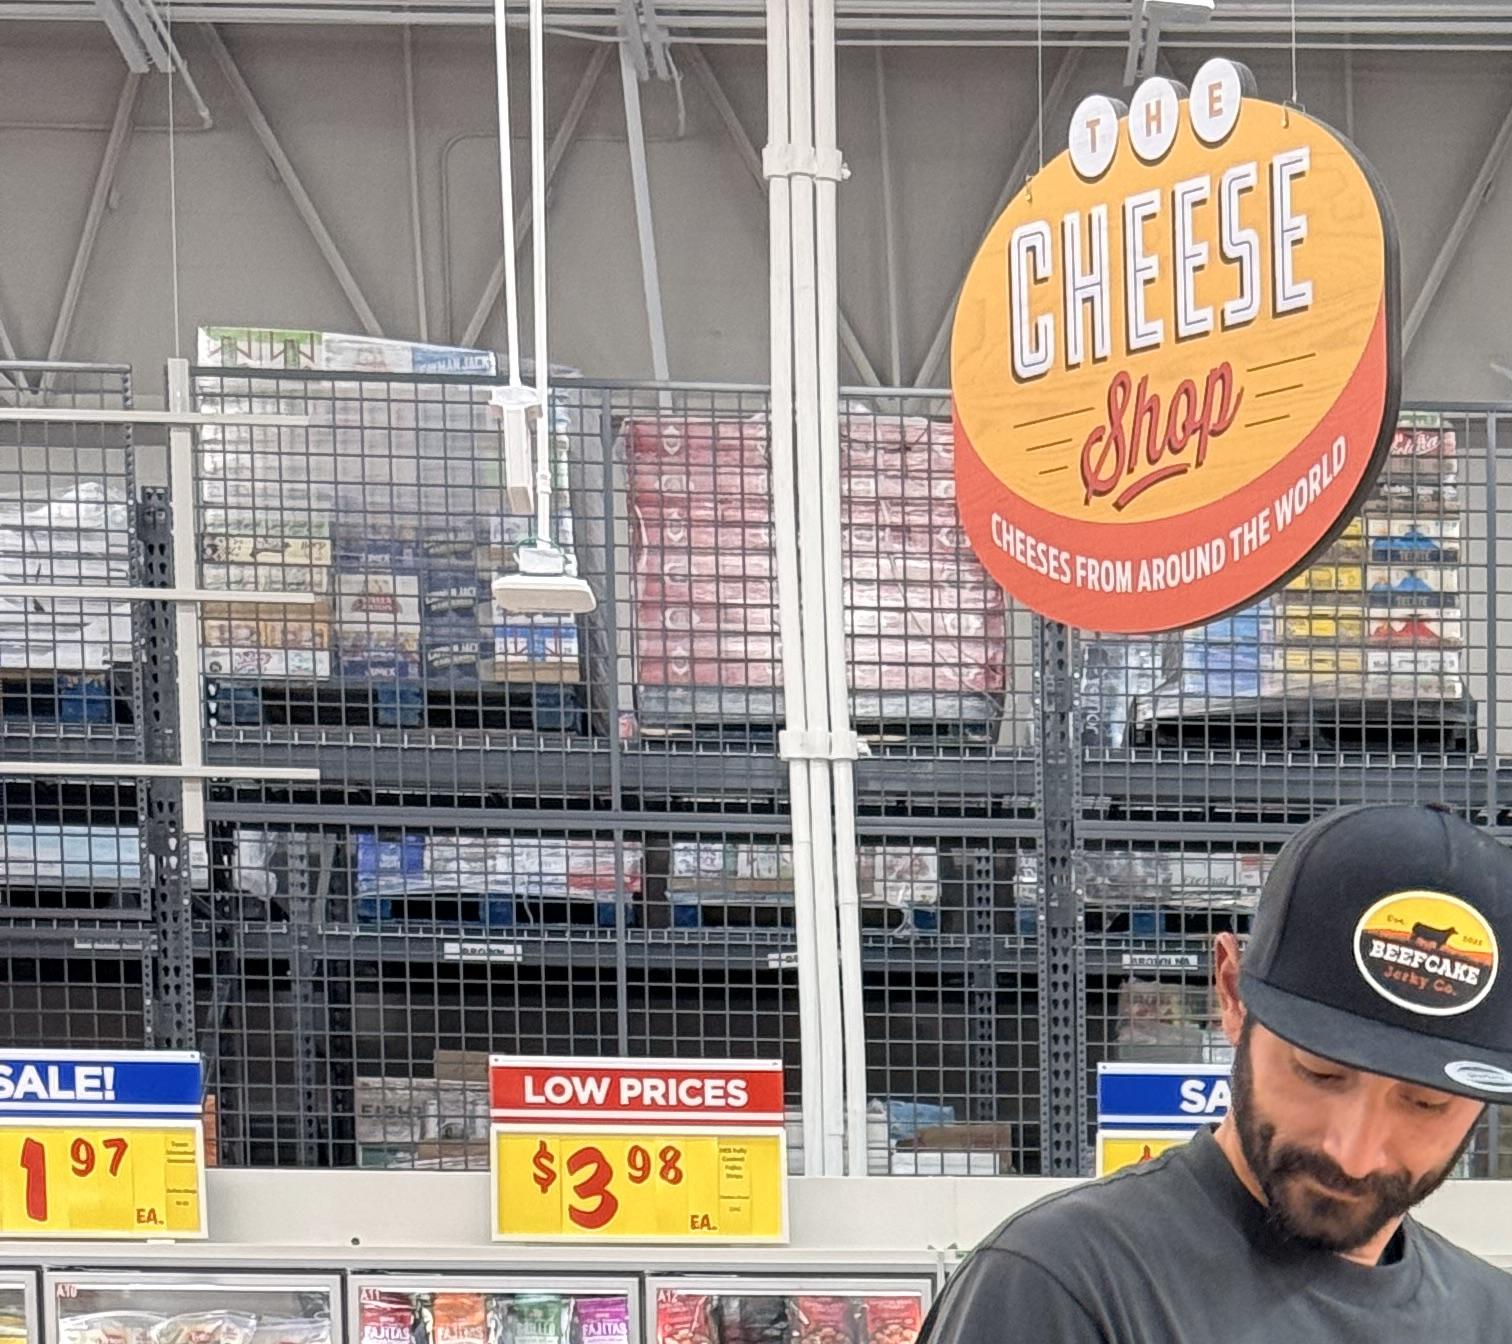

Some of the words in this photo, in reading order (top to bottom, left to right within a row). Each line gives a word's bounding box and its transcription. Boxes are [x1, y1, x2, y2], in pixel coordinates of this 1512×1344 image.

[1009, 146, 1312, 381] CHEESE
[1081, 361, 1244, 505] Shop
[990, 512, 1072, 584] CHEESES
[1075, 551, 1133, 594] FROM
[1136, 533, 1226, 593] AROUND
[1228, 507, 1272, 569] THE
[1273, 434, 1348, 538] WORLD
[1369, 939, 1481, 986] BEEFCAKE
[1384, 964, 1429, 990] Jerky
[1433, 978, 1457, 997] Co.
[0, 1065, 115, 1101] SALE!
[524, 1075, 611, 1105] LOW
[619, 1077, 749, 1108] PRICES
[70, 1137, 130, 1178] 97
[136, 1207, 165, 1225] EA.
[690, 1213, 719, 1231] EA.
[363, 1325, 411, 1342] FAJITAS
[582, 1321, 628, 1337] FAJITAS
